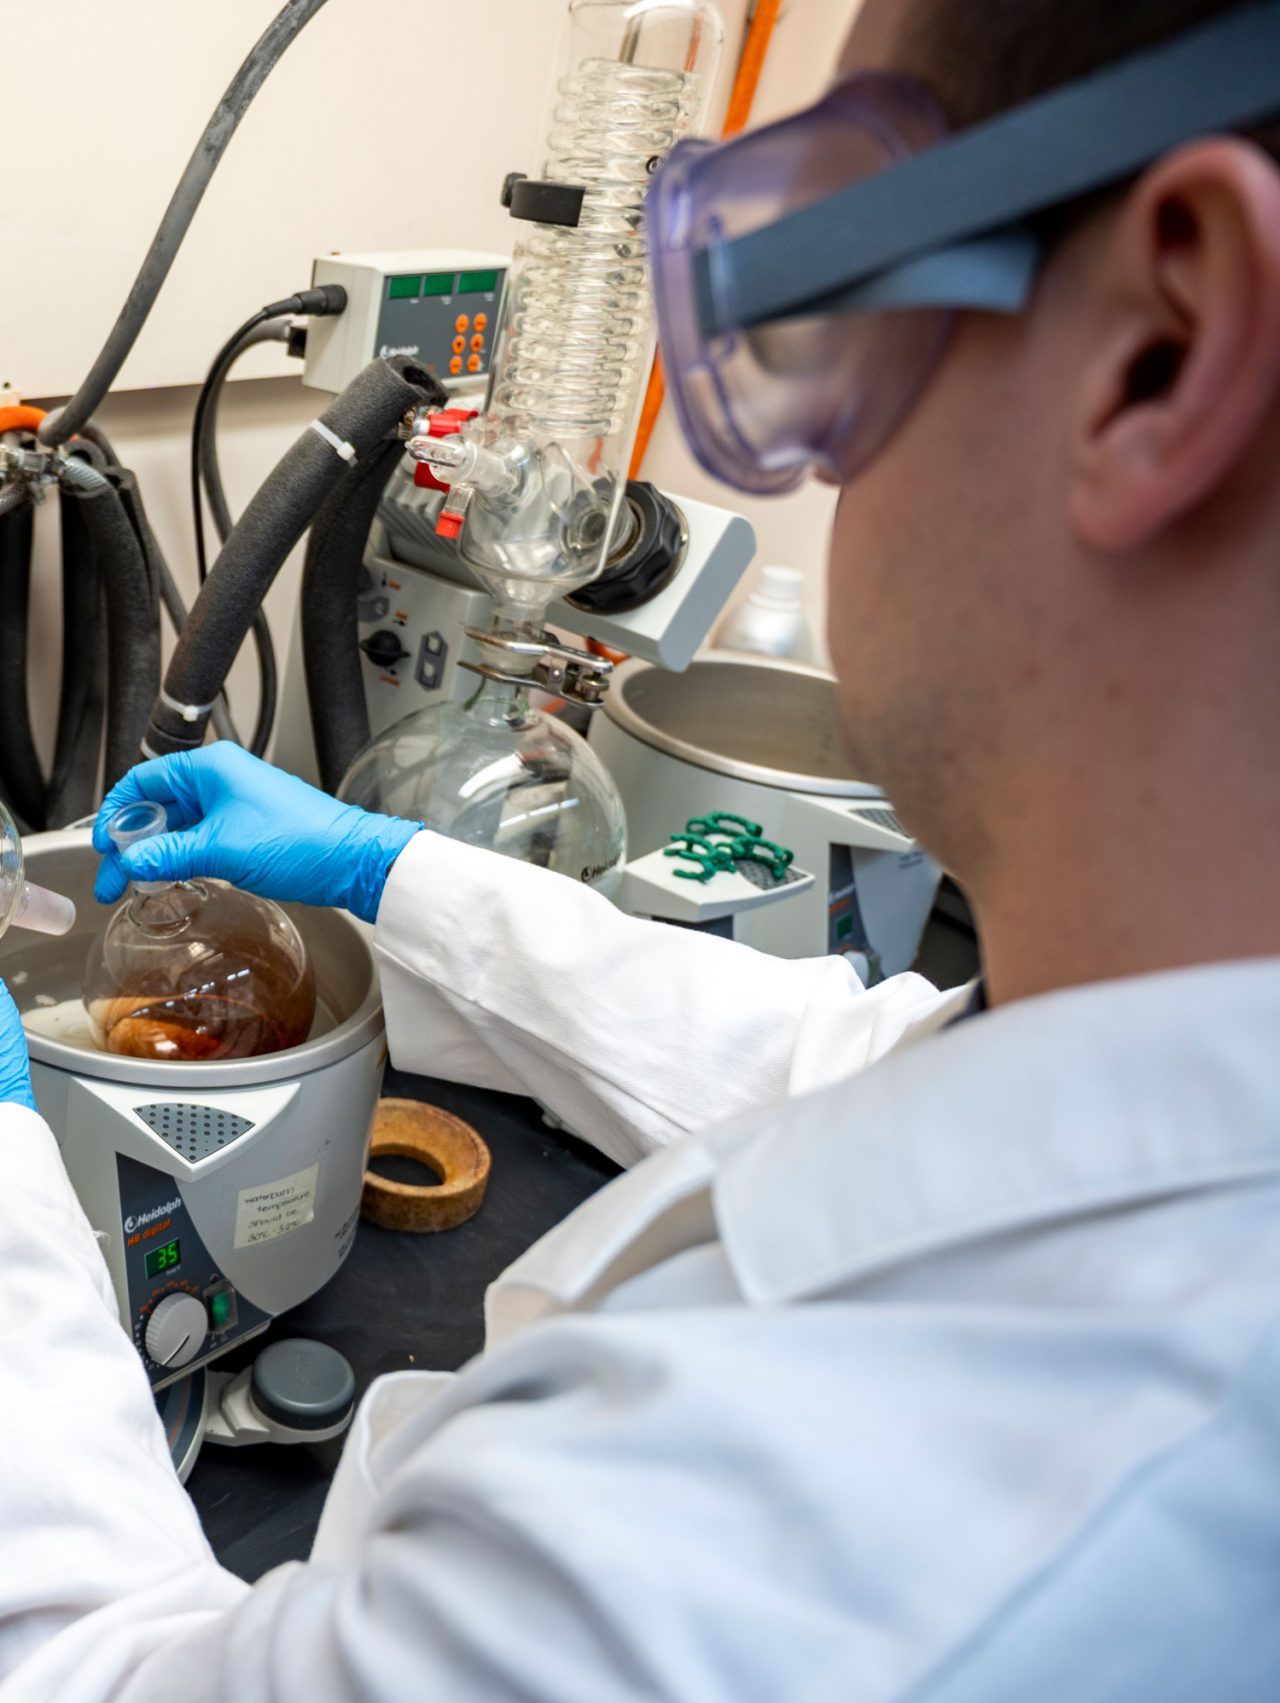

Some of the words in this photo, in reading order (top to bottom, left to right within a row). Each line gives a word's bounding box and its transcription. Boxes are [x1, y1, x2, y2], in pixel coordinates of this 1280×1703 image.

[137, 1197, 182, 1227] Heidolph
[127, 1233, 142, 1247] HB
[143, 1218, 173, 1240] digital
[158, 1242, 178, 1269] 35
